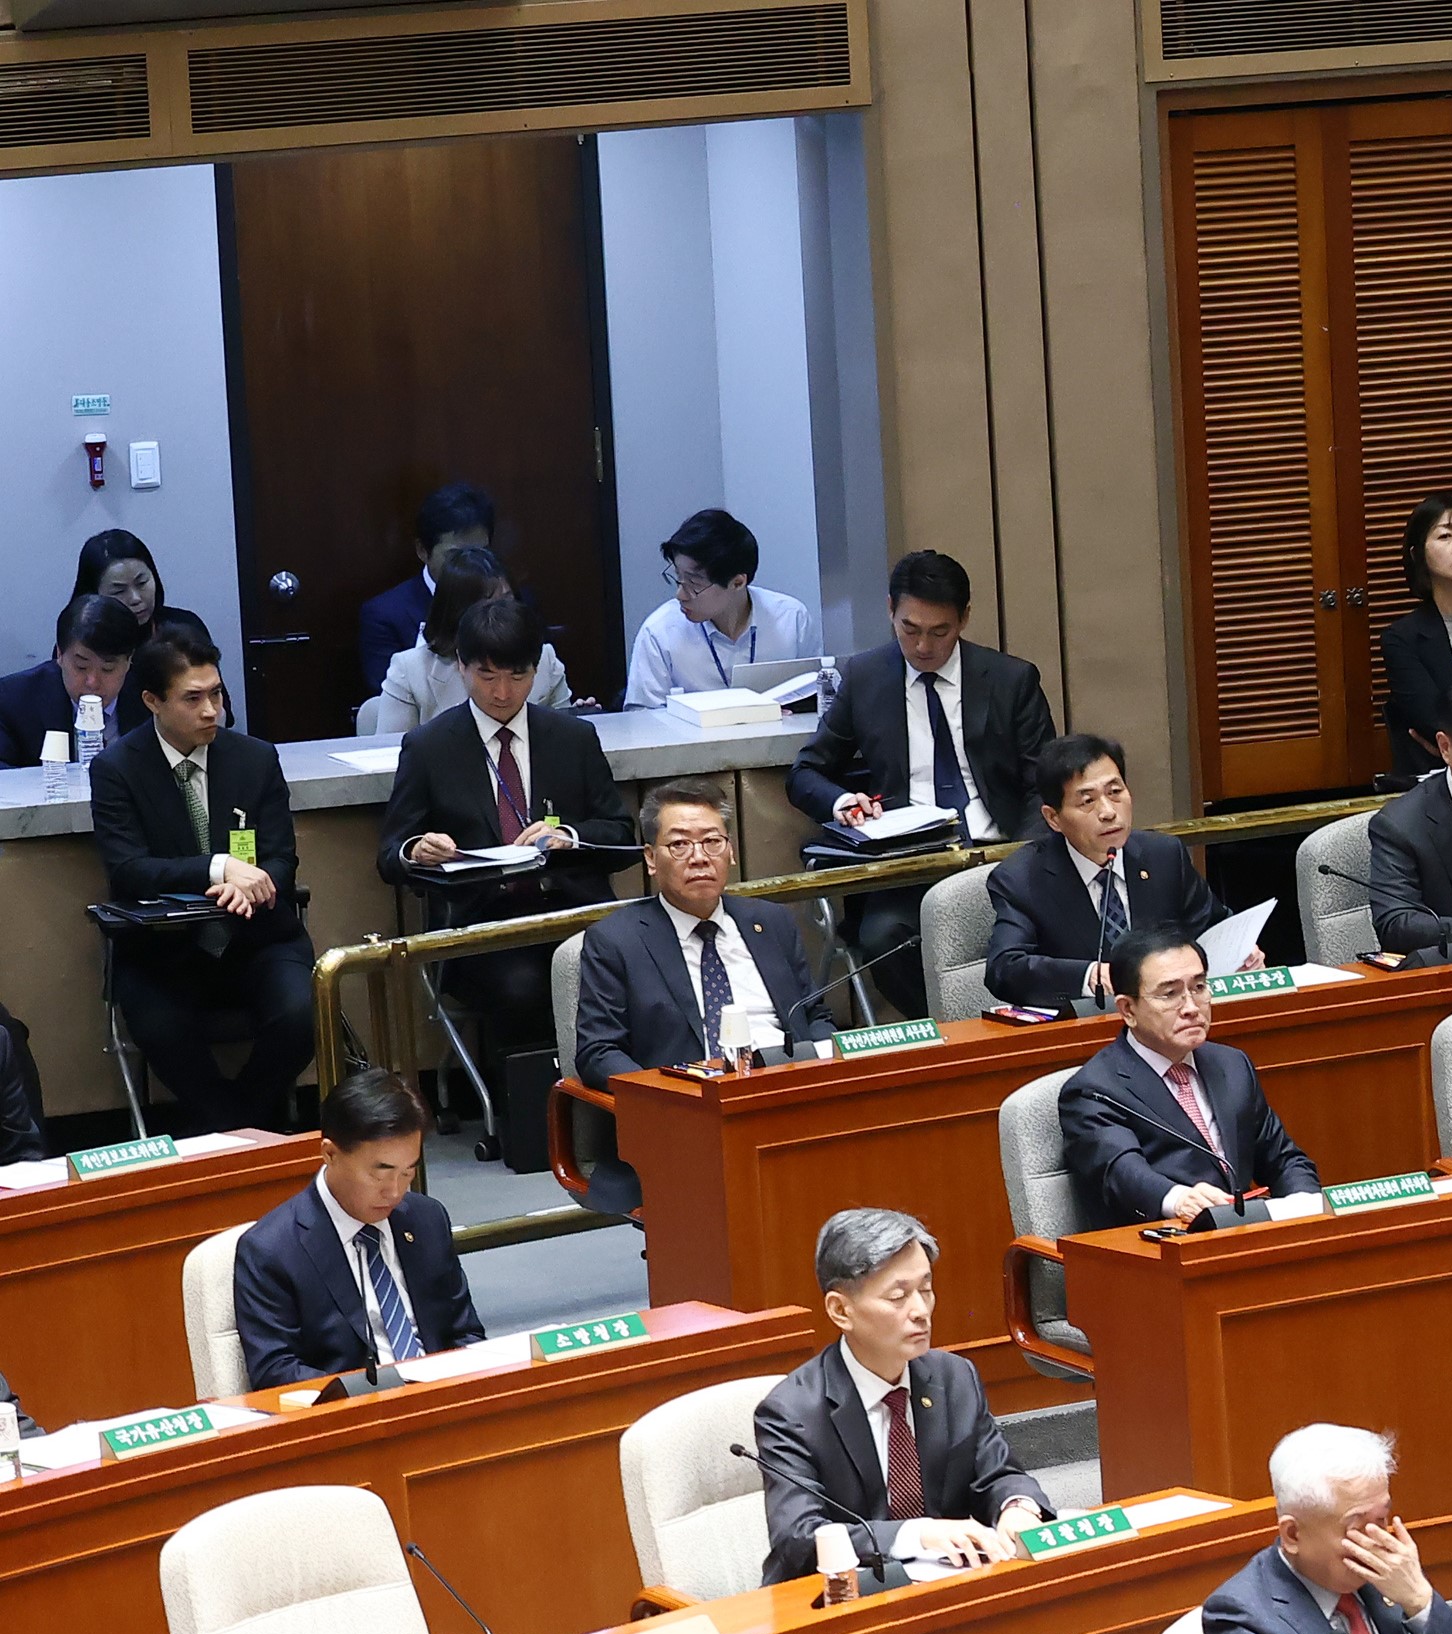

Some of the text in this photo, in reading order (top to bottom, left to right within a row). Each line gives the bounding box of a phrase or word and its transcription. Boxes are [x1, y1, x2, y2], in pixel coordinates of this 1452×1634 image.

[1232, 971, 1286, 990] 사무총장
[906, 1022, 936, 1039] 사무총장
[80, 1139, 170, 1170] 개인정보보호위원장
[1401, 1176, 1429, 1194] 사무처장
[556, 1319, 629, 1348] 소방청장
[115, 1411, 204, 1446] 국가유산청장
[1037, 1513, 1115, 1546] 경찰청장
